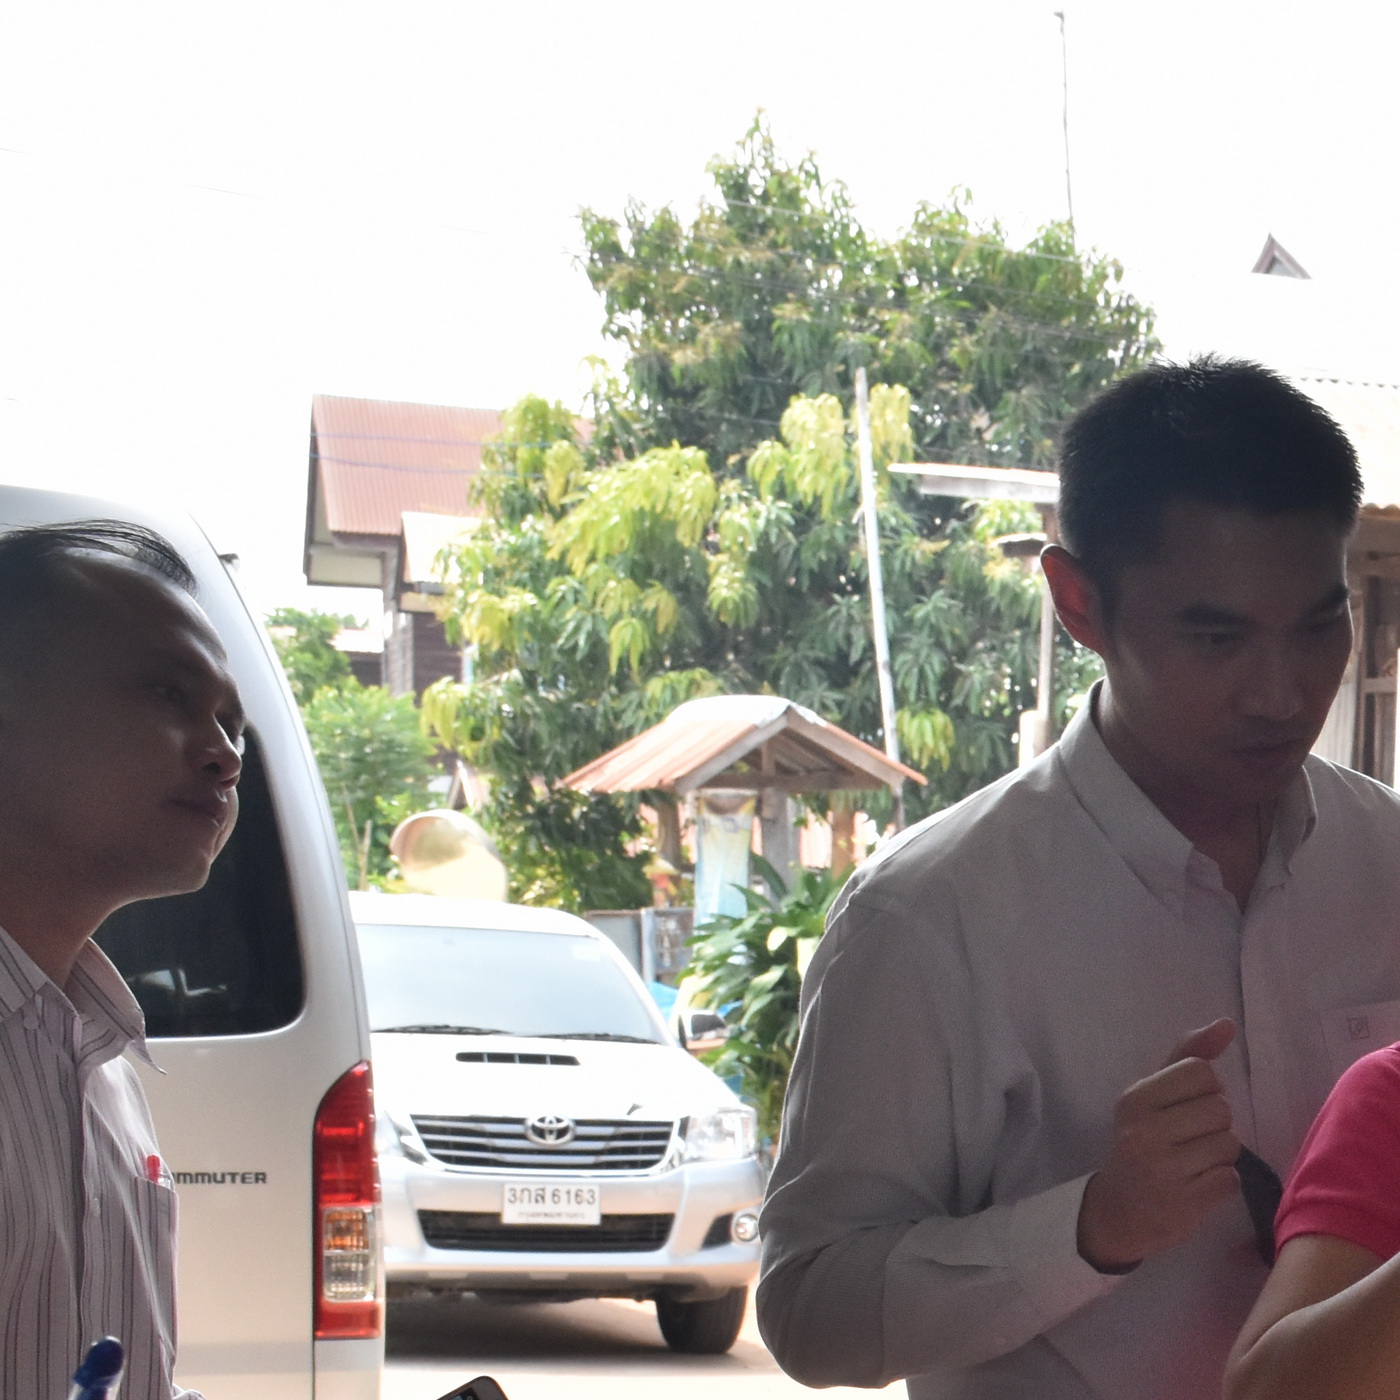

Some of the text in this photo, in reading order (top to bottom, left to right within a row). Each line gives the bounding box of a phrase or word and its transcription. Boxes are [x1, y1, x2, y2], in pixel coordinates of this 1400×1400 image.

[172, 1171, 268, 1185] MMUTER
[507, 1187, 596, 1206] 3กส 6163
